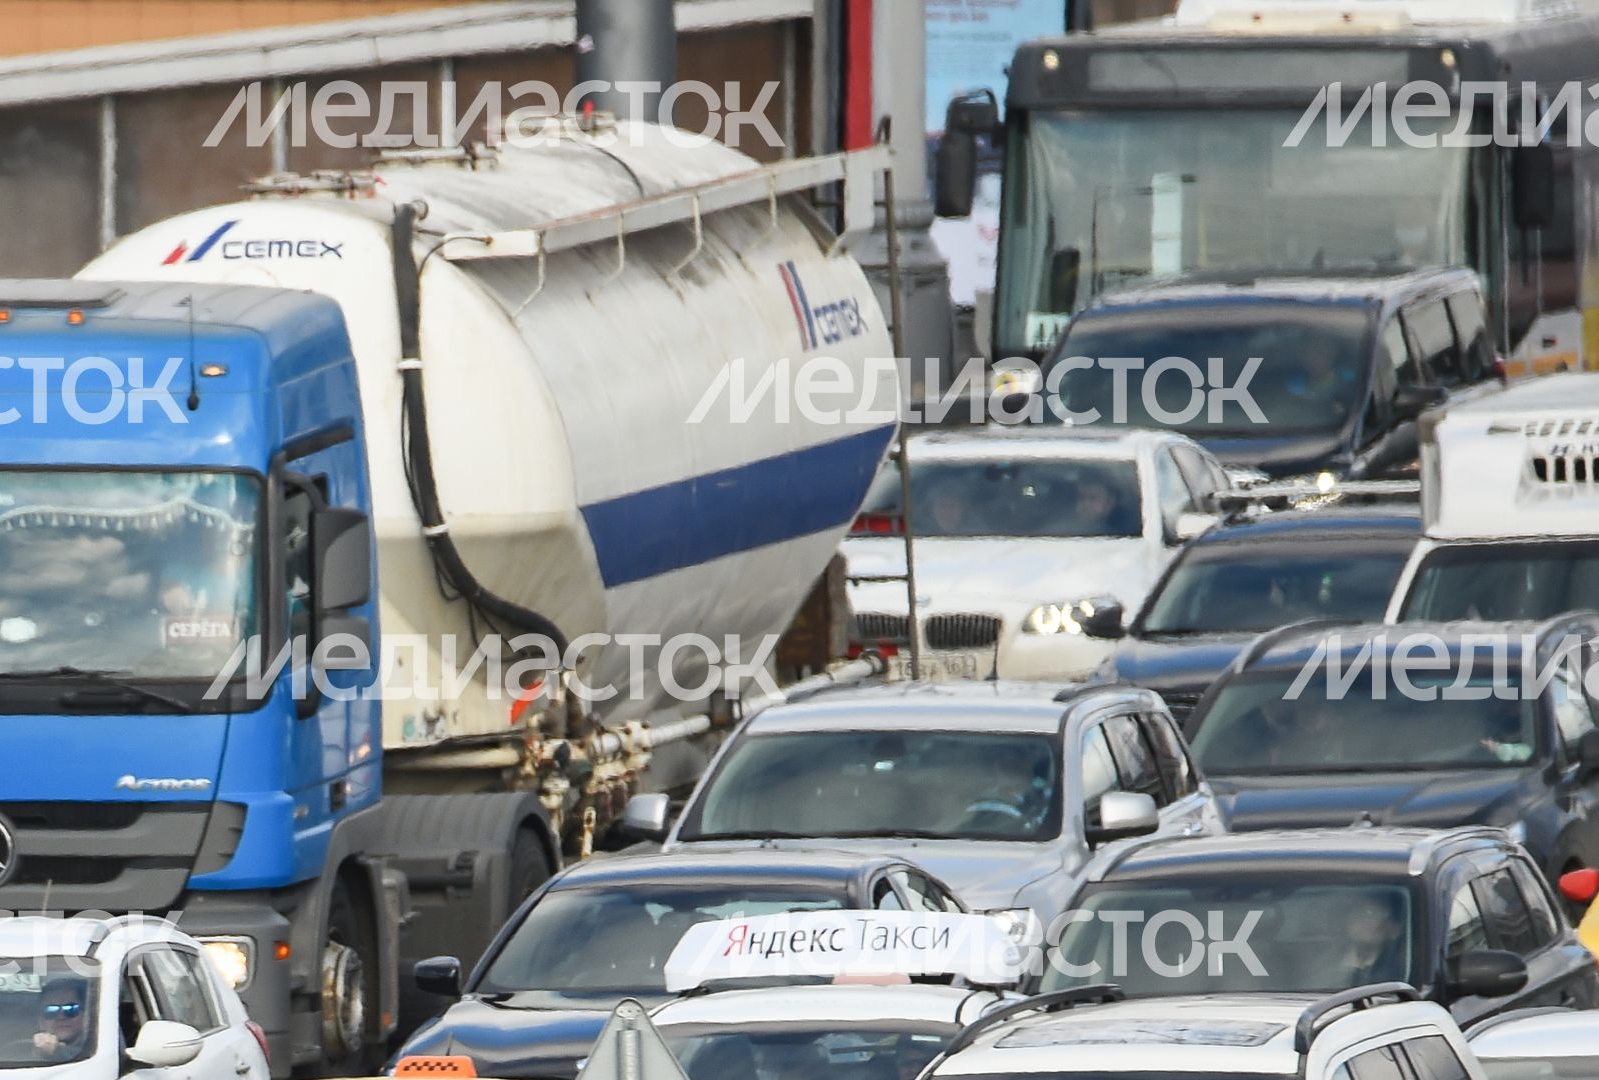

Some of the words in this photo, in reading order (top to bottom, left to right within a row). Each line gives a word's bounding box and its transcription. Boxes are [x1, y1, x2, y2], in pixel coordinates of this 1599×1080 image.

[222, 240, 344, 260] CEMEX
[723, 924, 845, 960] Яндекс
[857, 917, 950, 951] Такси
